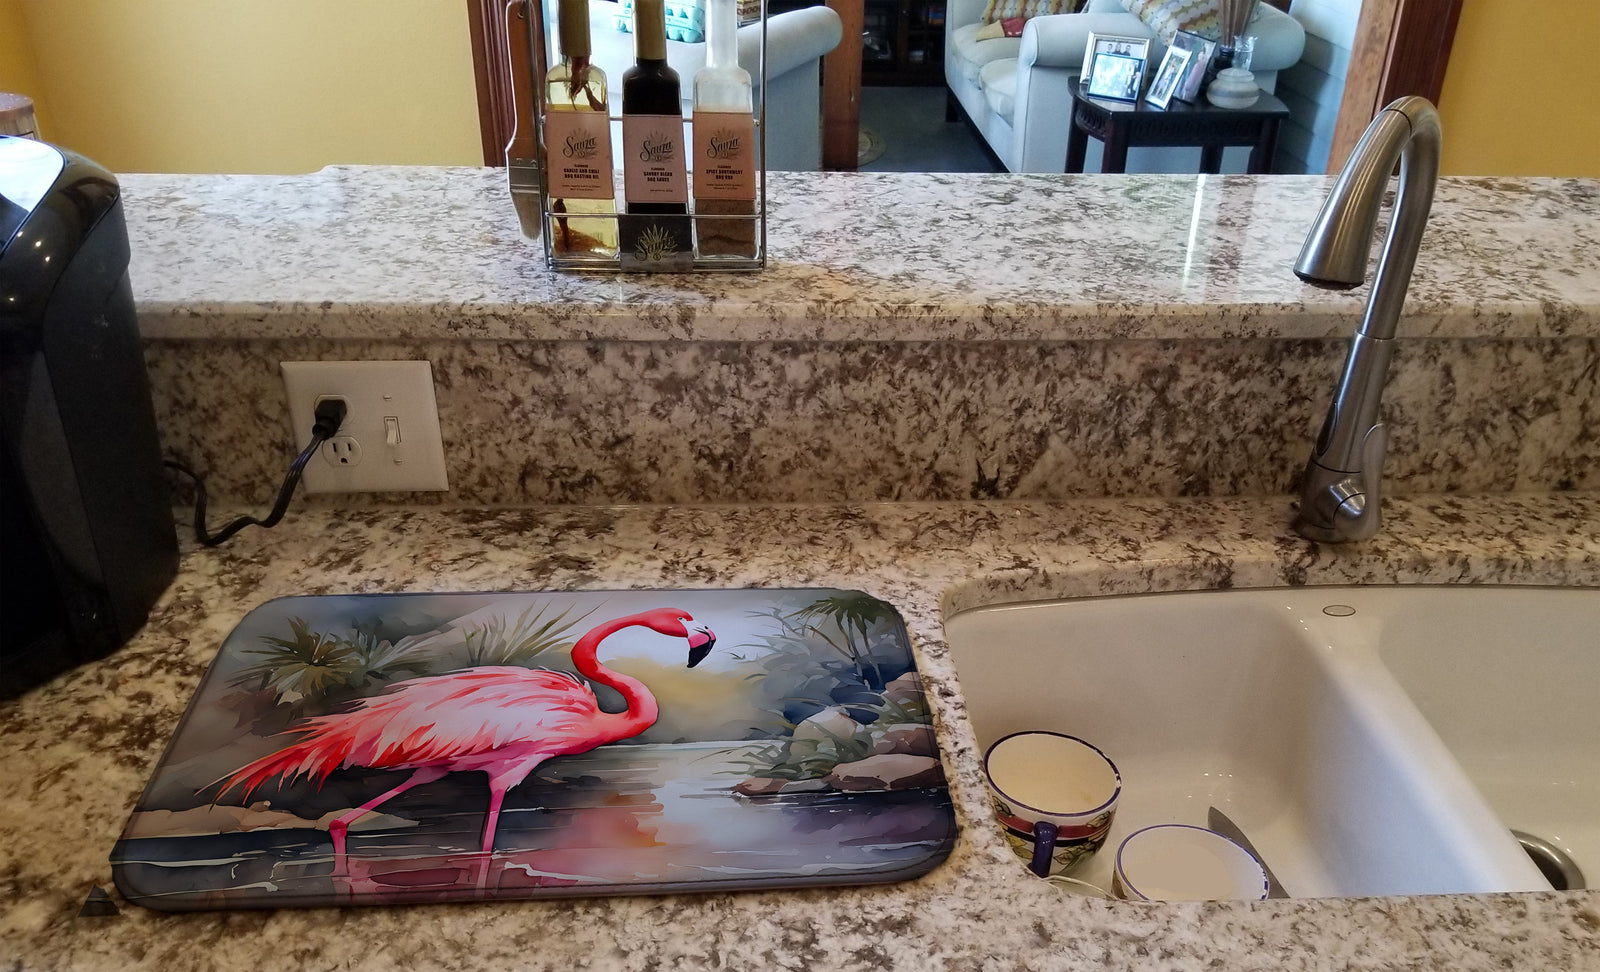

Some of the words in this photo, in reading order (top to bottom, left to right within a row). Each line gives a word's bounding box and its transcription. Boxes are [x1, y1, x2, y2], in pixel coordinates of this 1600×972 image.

[562, 136, 597, 158] Sauza
[640, 140, 673, 162] Sauza
[707, 137, 739, 159] Sauza
